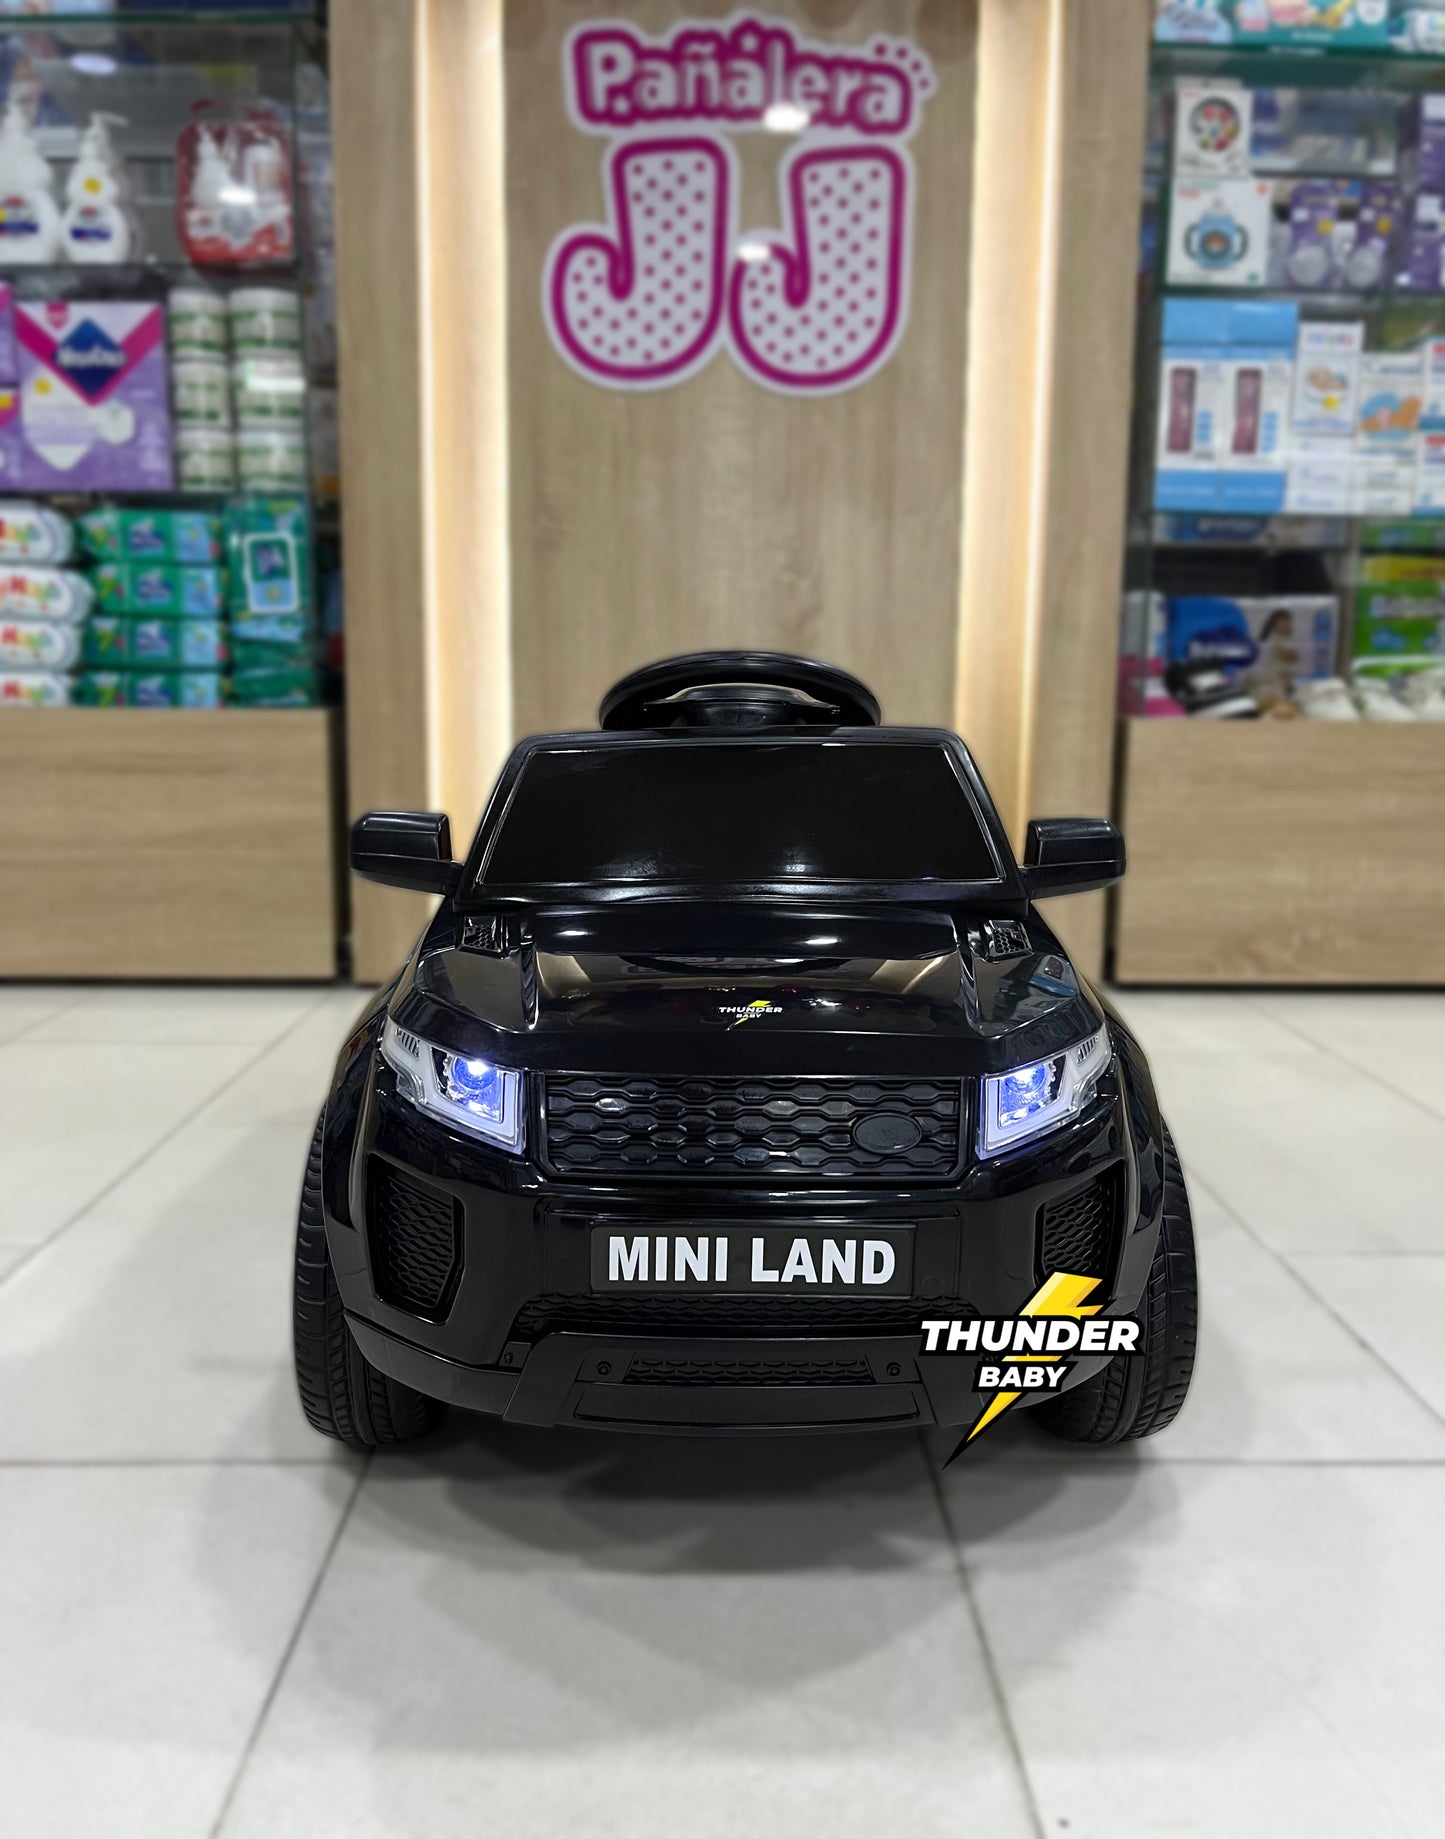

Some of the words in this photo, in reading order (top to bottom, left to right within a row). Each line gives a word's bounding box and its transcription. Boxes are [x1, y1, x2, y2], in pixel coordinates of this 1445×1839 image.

[582, 33, 908, 128] Pañalera
[550, 136, 905, 388] JJ
[719, 1006, 783, 1014] THUNDER
[608, 1235, 729, 1282] MINI
[751, 1237, 896, 1285] LAND
